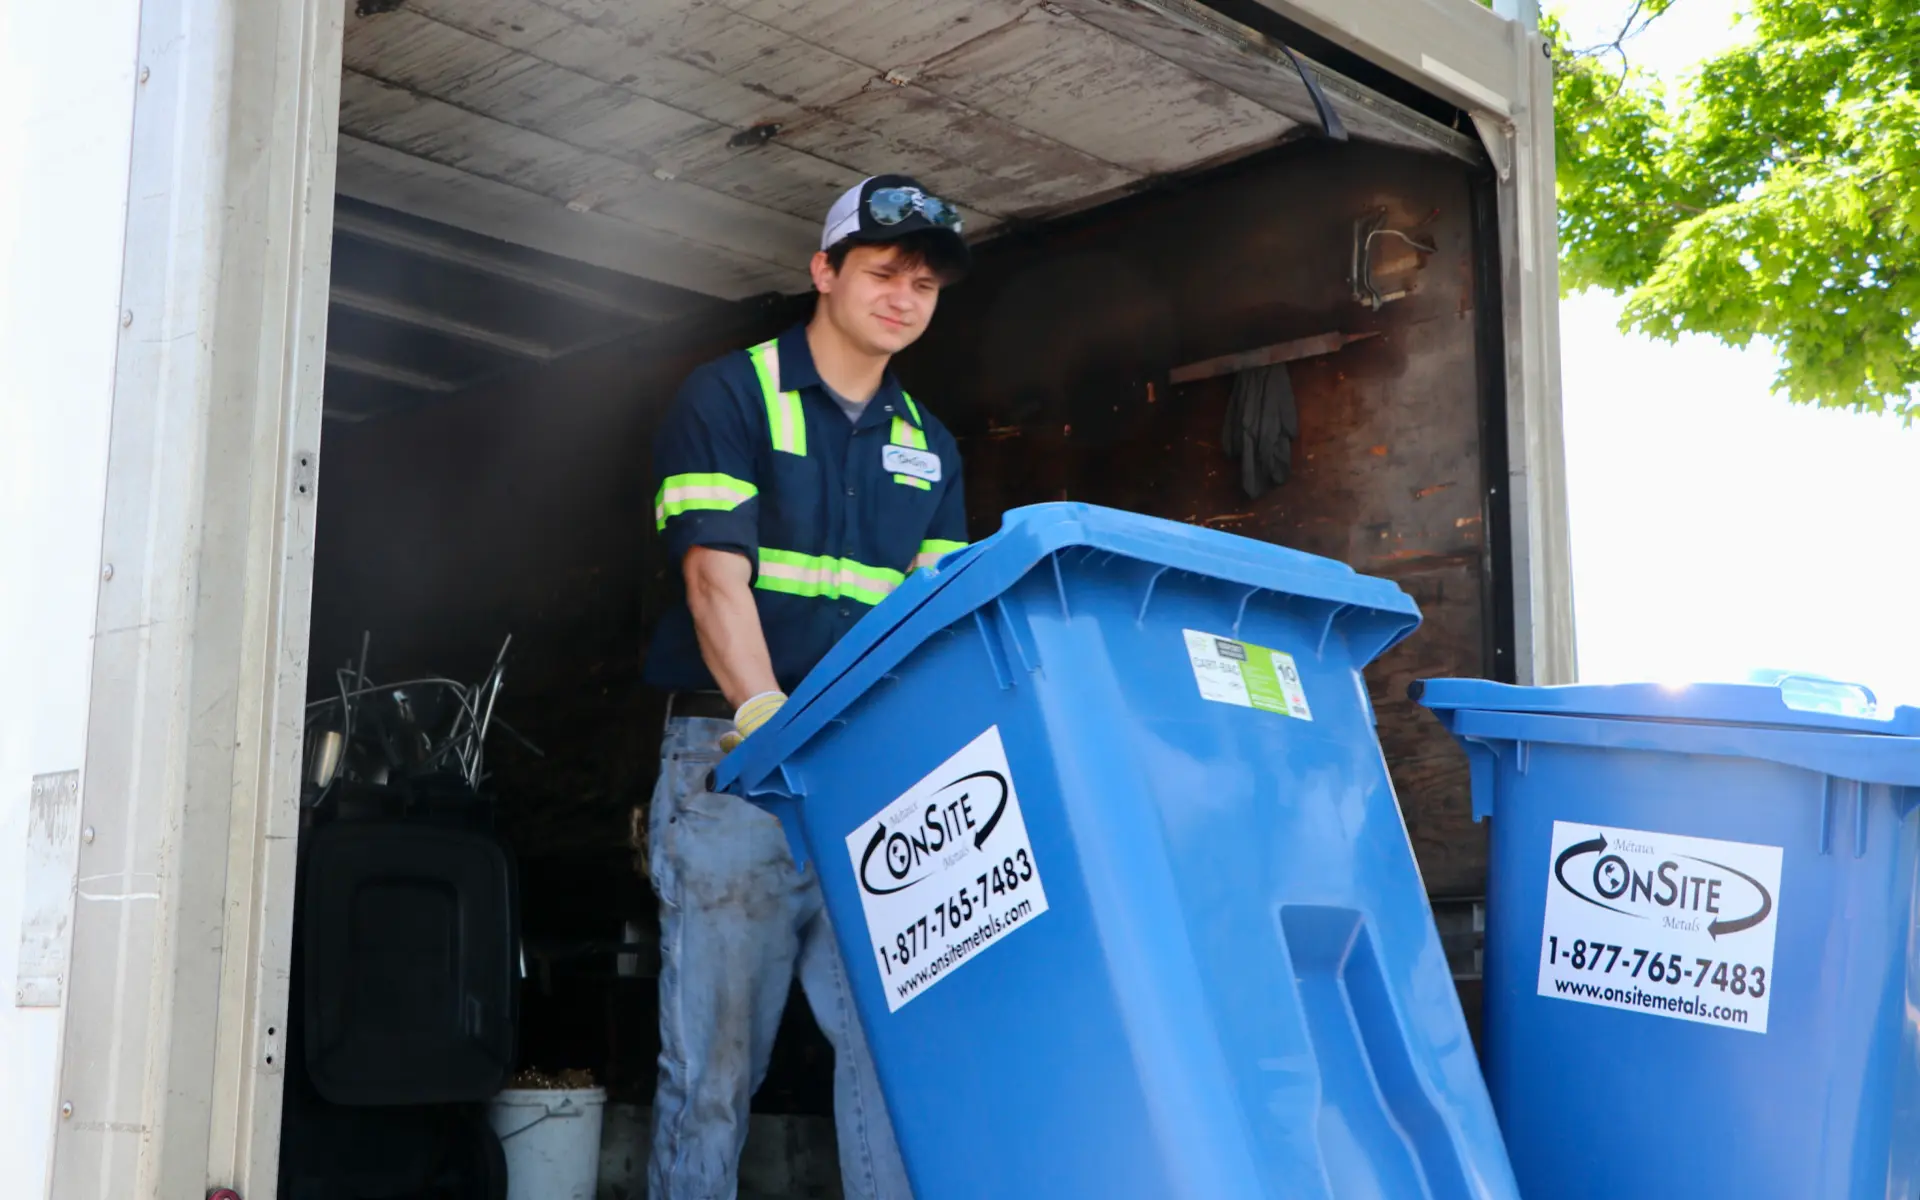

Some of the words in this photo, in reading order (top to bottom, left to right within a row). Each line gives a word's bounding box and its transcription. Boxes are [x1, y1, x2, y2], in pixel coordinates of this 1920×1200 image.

[1613, 838, 1655, 855] Métaux
[880, 848, 1032, 975] 1-877-765-7483
[1593, 854, 1722, 913] ONSITE
[897, 899, 1032, 998] www.onsitemetals.com
[1662, 916, 1700, 933] Metals
[1548, 936, 1766, 998] 1-877-765-7483
[1555, 979, 1749, 1024] www.onsitemetals.com
